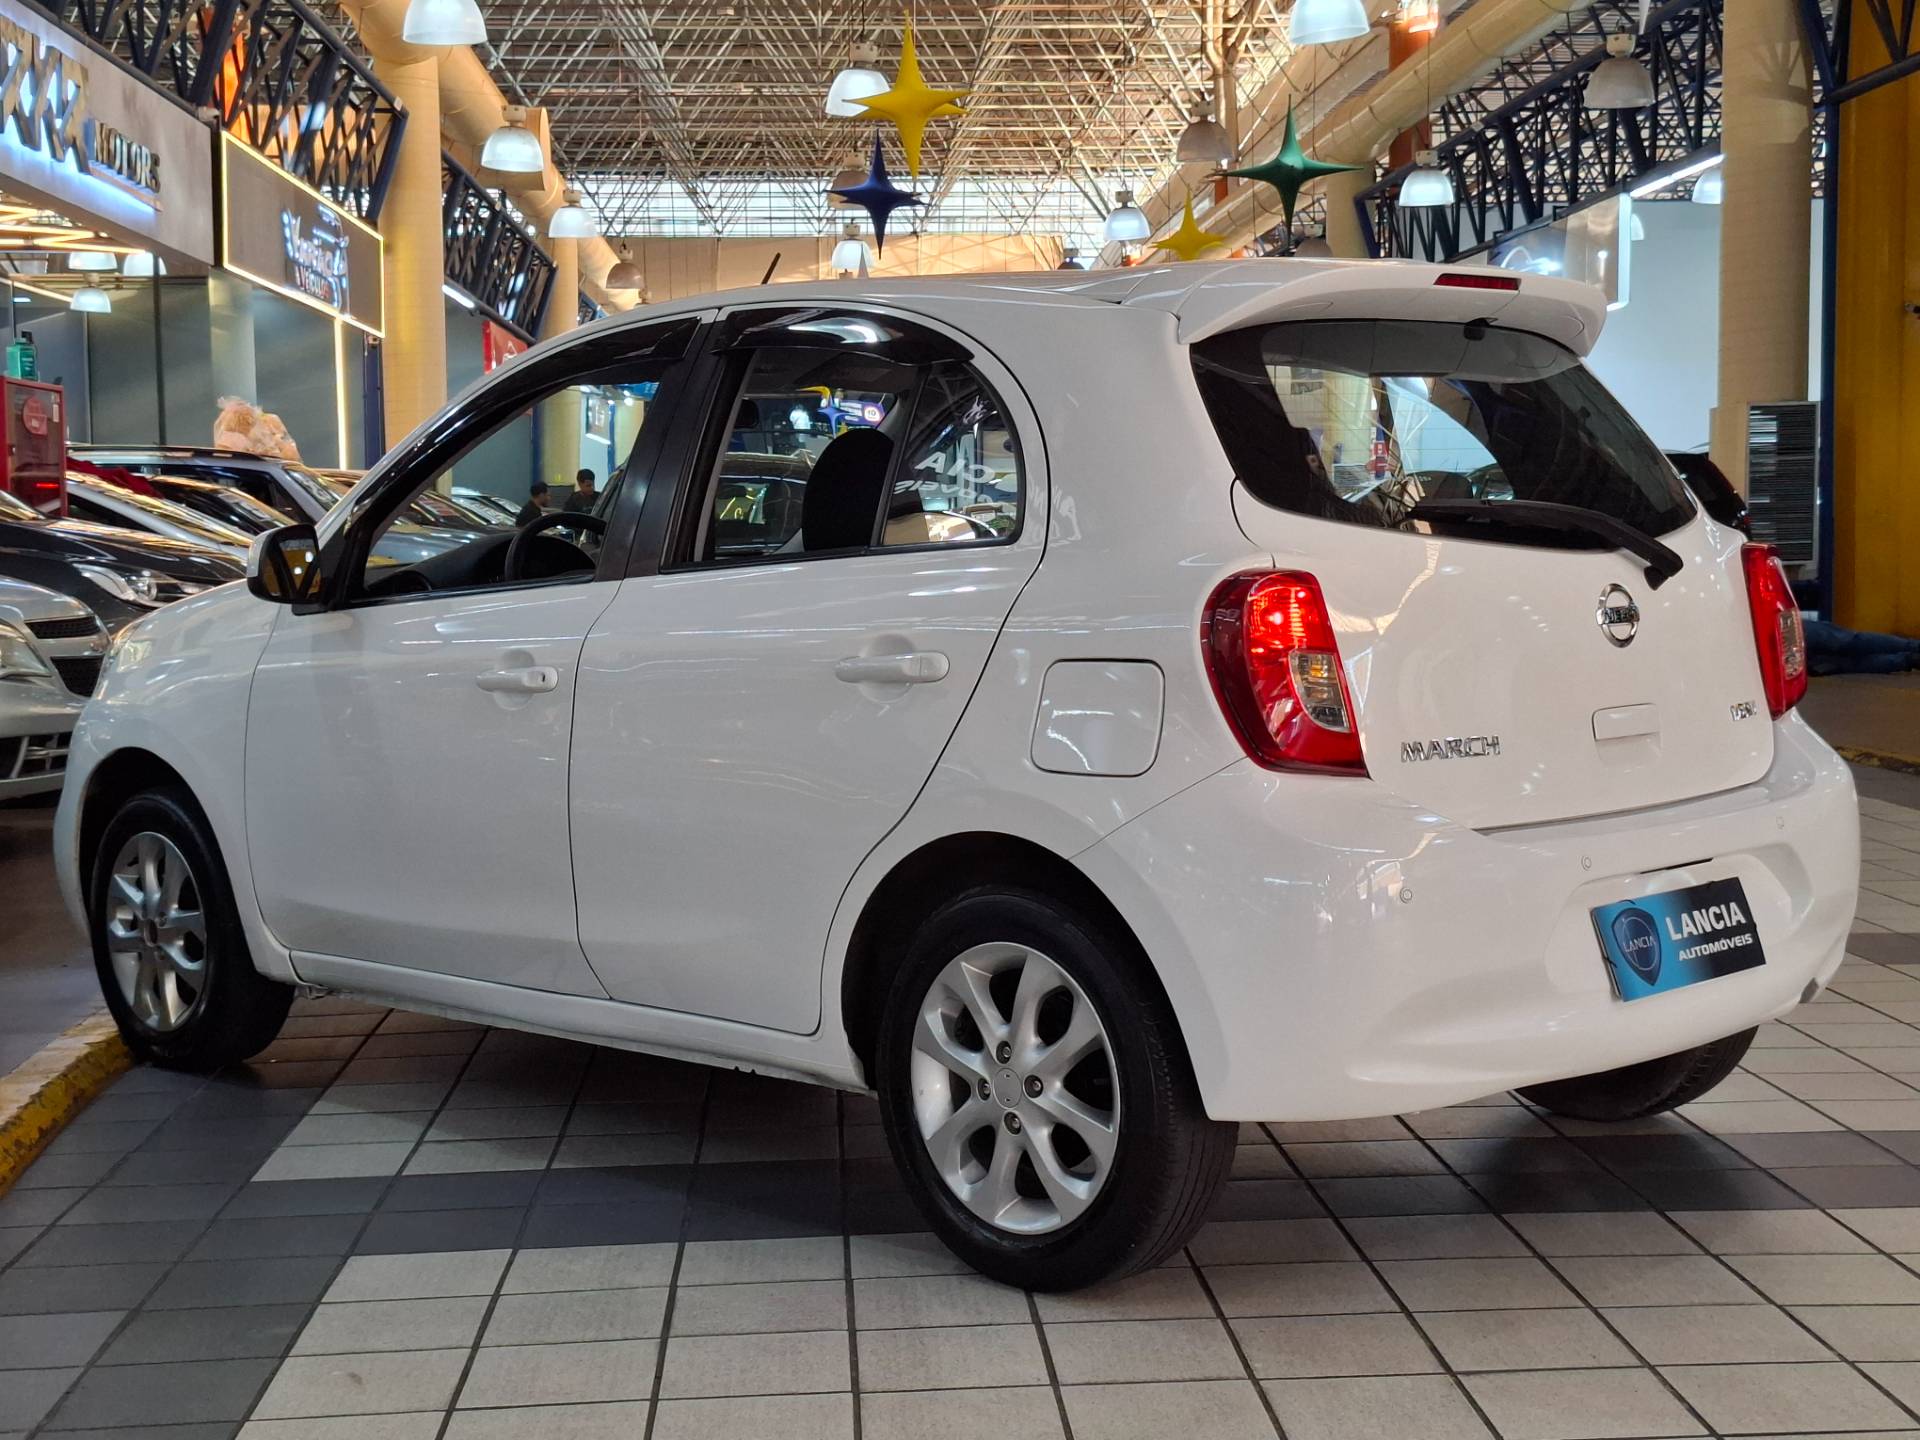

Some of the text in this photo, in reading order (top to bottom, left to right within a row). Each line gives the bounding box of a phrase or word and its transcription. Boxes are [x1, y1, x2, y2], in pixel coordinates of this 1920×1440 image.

[94, 119, 161, 193] MOTORS
[1400, 735, 1500, 762] MARCH
[1665, 902, 1746, 941] LANCIA
[1623, 935, 1656, 953] LANCIA
[1679, 933, 1753, 961] AUTOMÓVEIS
